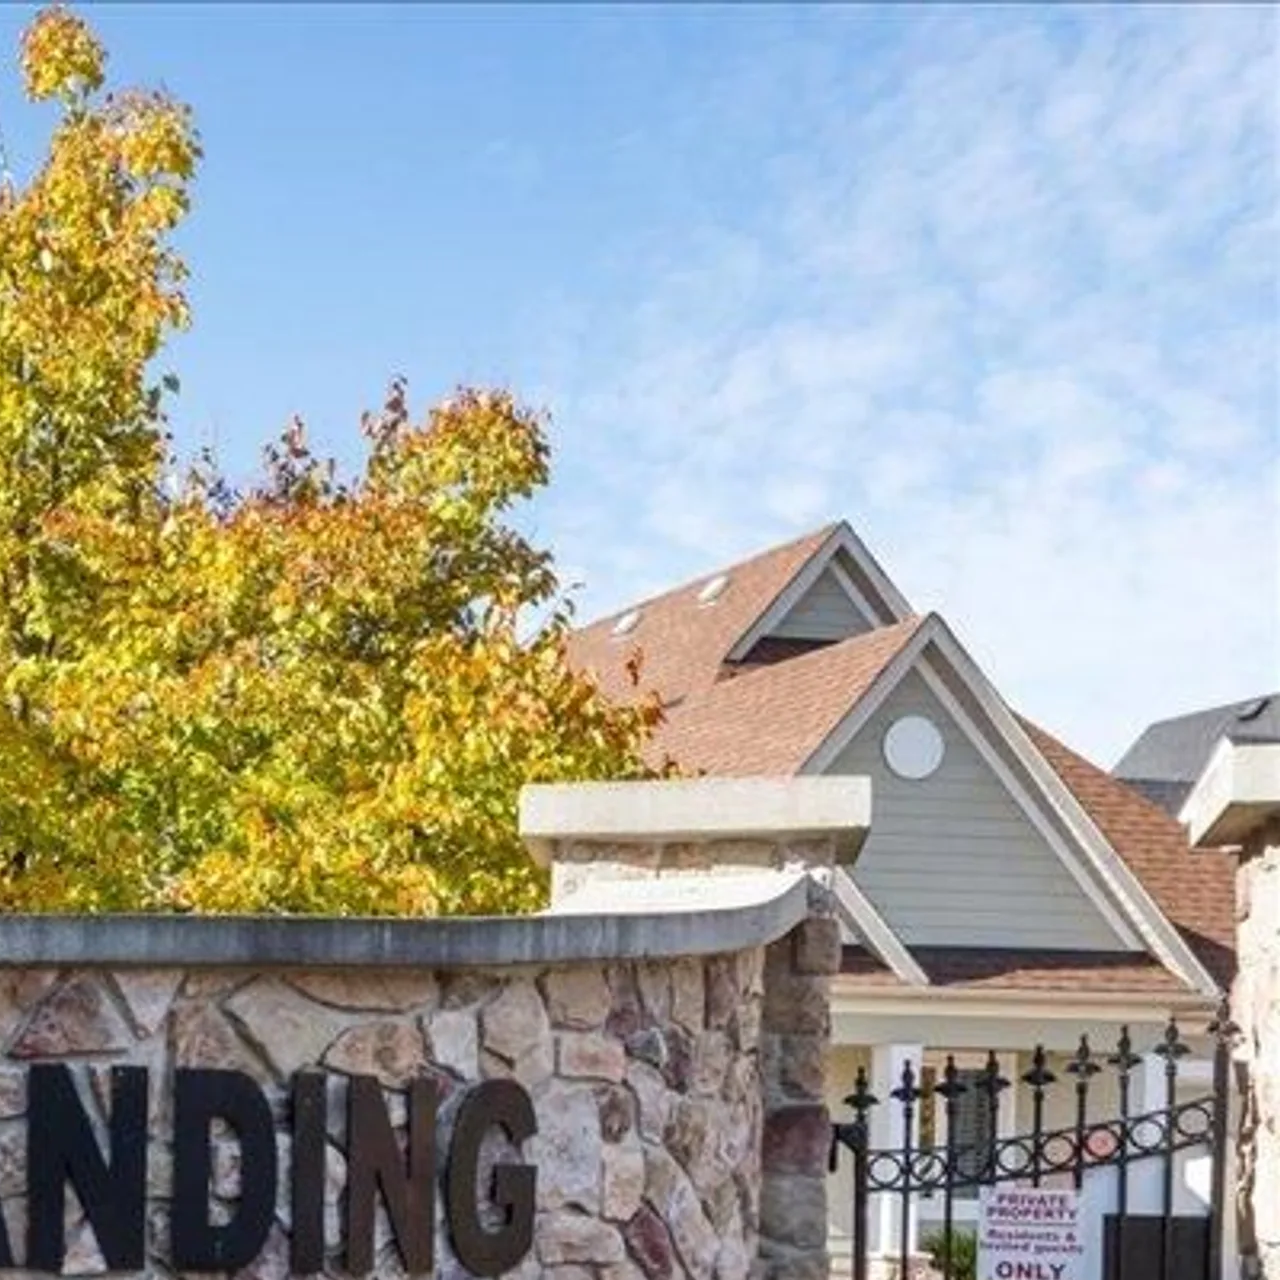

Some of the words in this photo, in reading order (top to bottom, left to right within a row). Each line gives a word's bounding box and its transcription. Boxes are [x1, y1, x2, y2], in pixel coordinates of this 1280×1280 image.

[997, 1193, 1067, 1206] PRIVATE
[987, 1206, 1077, 1220] PROPERTY
[995, 1260, 1067, 1280] ONLY
